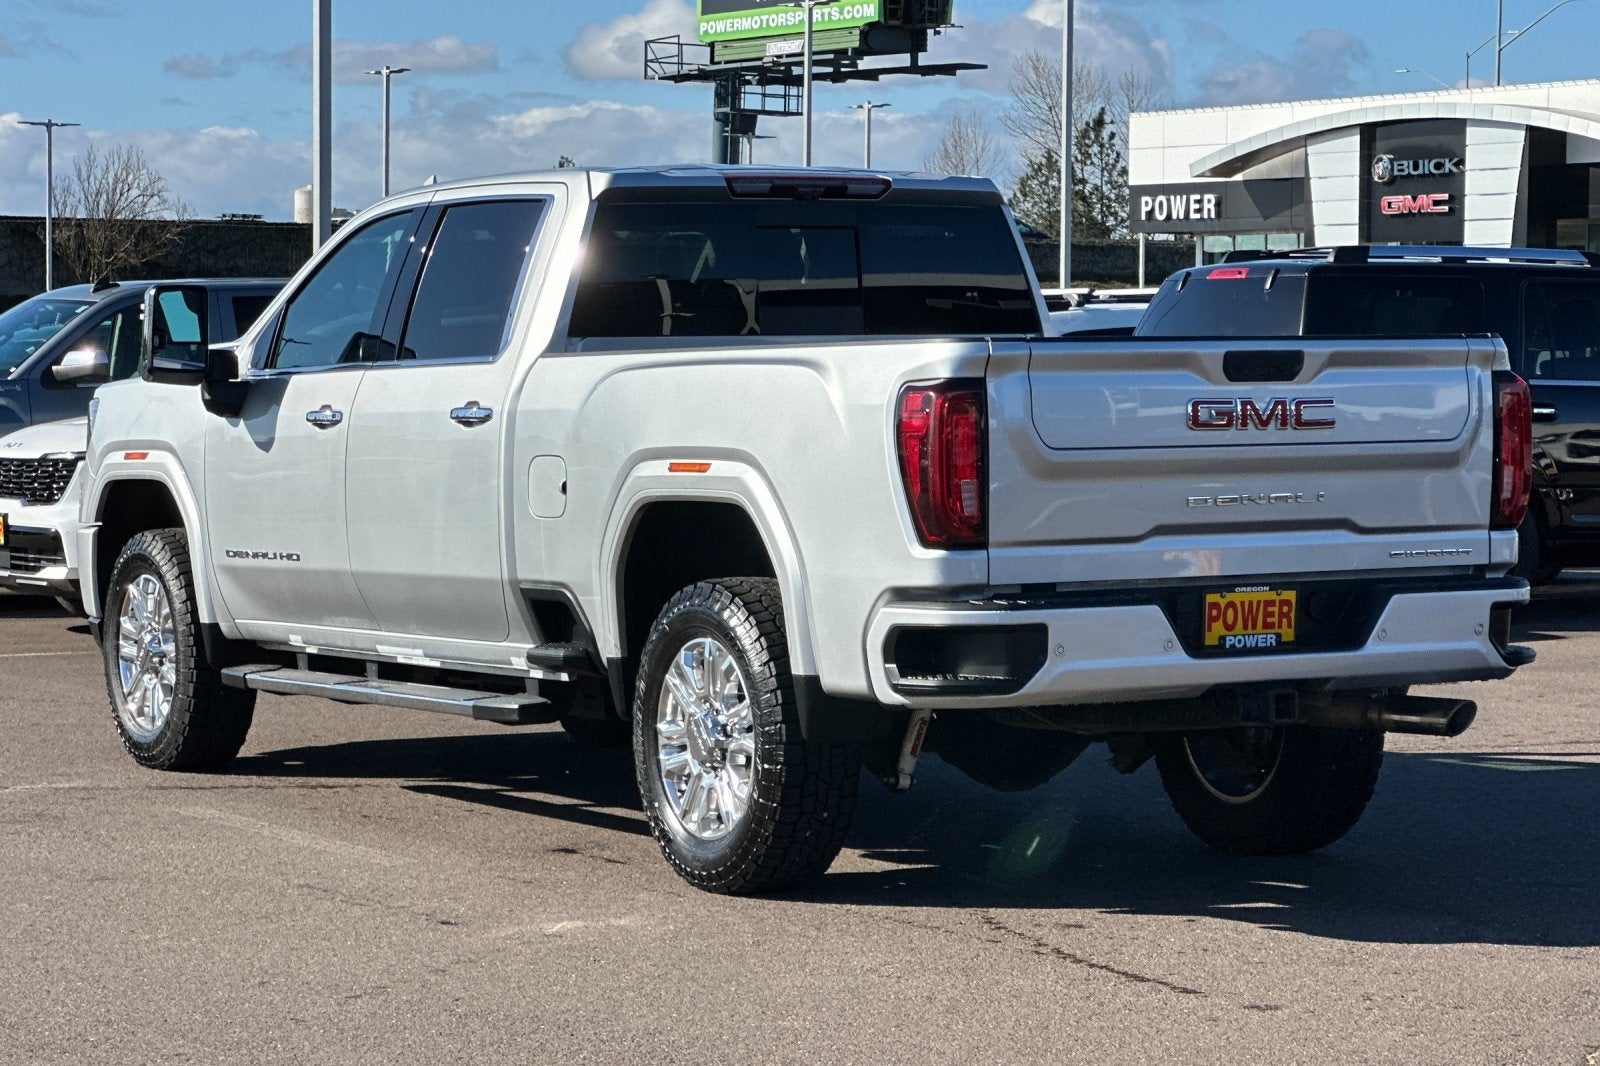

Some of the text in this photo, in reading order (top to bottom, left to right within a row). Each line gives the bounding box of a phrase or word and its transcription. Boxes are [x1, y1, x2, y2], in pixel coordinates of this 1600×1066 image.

[700, 4, 875, 35] POWERMOTORSPRTS.COM
[1393, 158, 1460, 176] BUICK
[1141, 194, 1216, 220] POWER
[1381, 193, 1449, 214] GMC
[1187, 397, 1336, 430] GMC
[1187, 491, 1325, 507] DENALI
[226, 549, 300, 561] DENALI HD
[1389, 548, 1473, 558] SIERRA
[1206, 599, 1294, 632] POWER
[1226, 634, 1276, 648] POWER
